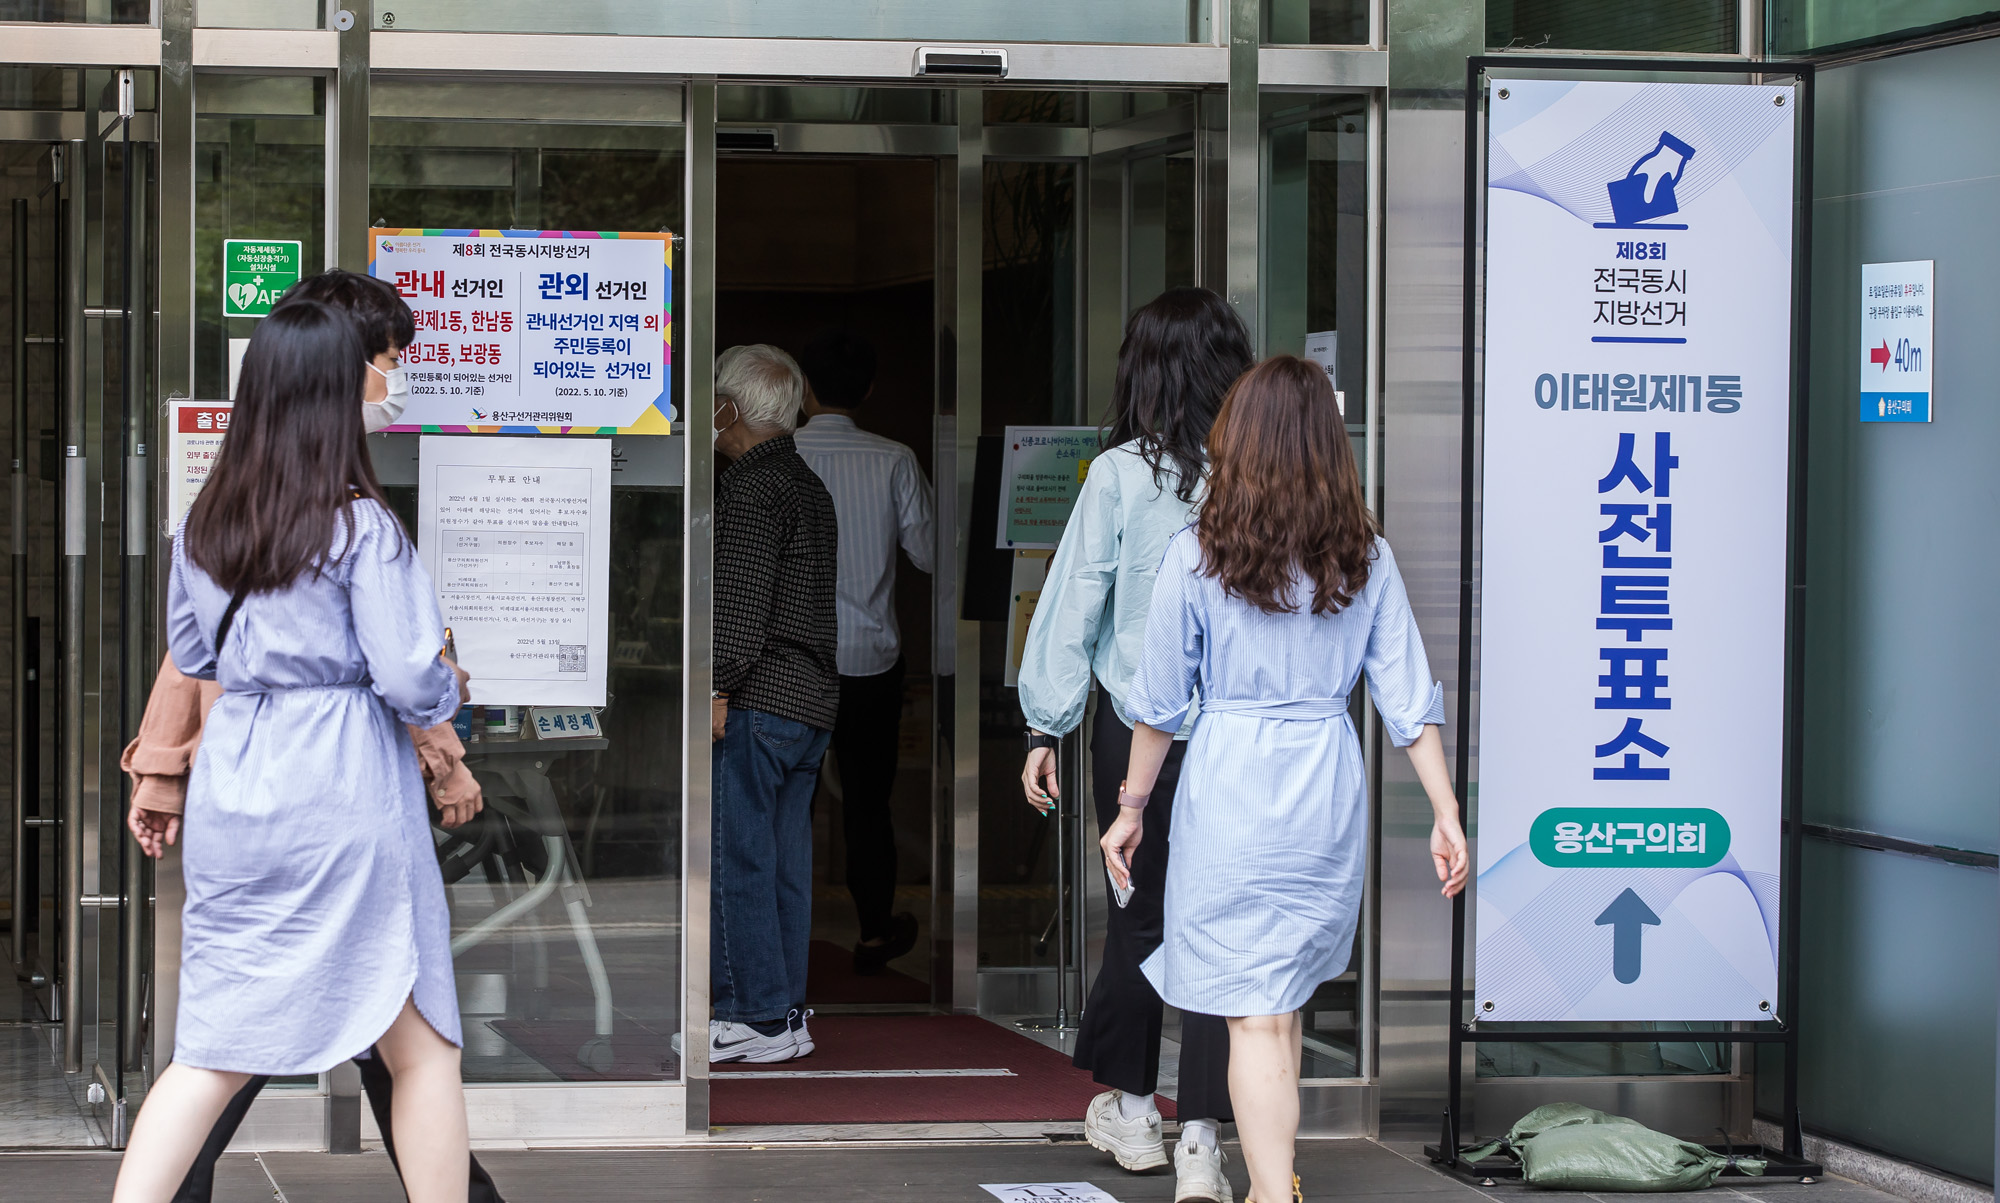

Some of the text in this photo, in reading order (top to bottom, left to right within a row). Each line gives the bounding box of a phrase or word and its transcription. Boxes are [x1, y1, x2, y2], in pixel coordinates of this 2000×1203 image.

[237, 254, 290, 263] (자동심장충격기)
[243, 246, 284, 254] 자동제세동기
[452, 243, 590, 259] 제8회 전국동시지방선거
[1616, 242, 1666, 260] 제8회
[250, 264, 276, 272] 설치시설
[394, 270, 503, 298] 관내 선거인
[538, 272, 647, 300] 관외 선거인
[1594, 268, 1687, 294] 전국동시
[256, 290, 286, 304] AE
[412, 309, 514, 334] 원제1동, 한남동
[526, 313, 658, 332] 관내선거인 지역 외
[1593, 301, 1687, 326] 지방선거
[460, 343, 502, 365] 보광동
[554, 338, 631, 356] 주민등록이
[1894, 338, 1922, 372] 40m
[410, 372, 512, 383] 주민등록이 되어있는 선거인
[533, 361, 651, 380] 되어있는 선거인
[412, 385, 485, 396] (2022. 5. 10. 기준)
[556, 387, 628, 398] (2022. 5. 10. 기준)
[1534, 373, 1742, 414] 이태원제1동
[1886, 399, 1912, 414] 용산구의회
[492, 410, 572, 422] 용산구선거관리위원회
[1021, 436, 1080, 447] 신종코로나바이러스
[186, 452, 201, 460] 외부
[186, 466, 208, 474] 지정된
[488, 474, 541, 484] 무투표 안내
[1592, 432, 1679, 780] 사전투표소
[538, 713, 594, 732] 손세정제
[1554, 822, 1706, 854] 용산구의회
